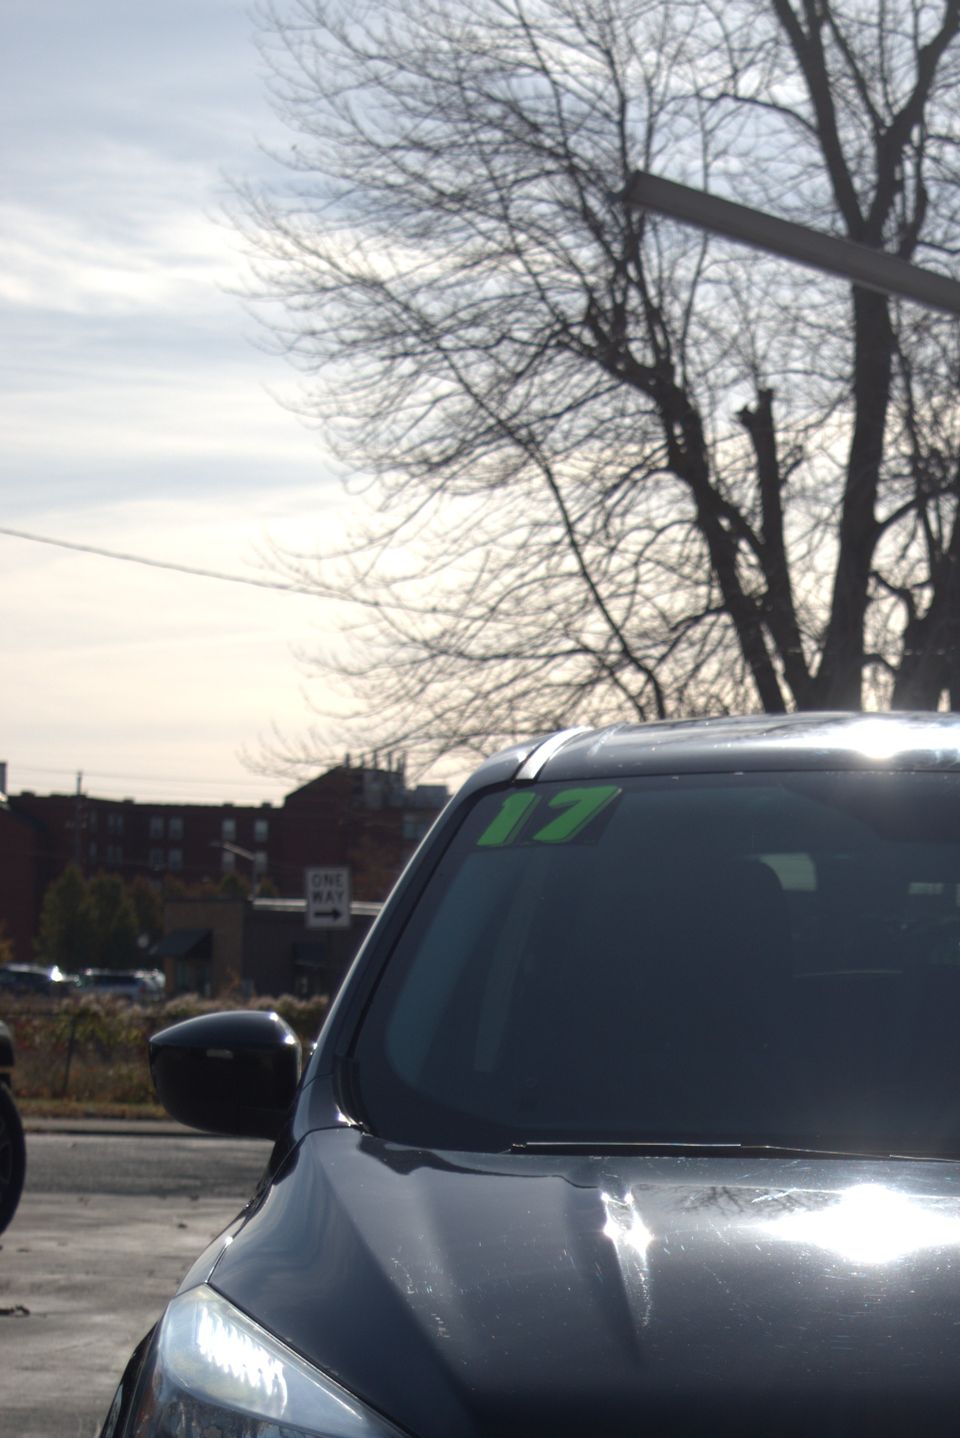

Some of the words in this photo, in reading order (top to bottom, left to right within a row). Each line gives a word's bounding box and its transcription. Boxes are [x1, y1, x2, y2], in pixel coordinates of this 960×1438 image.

[477, 785, 622, 846] 17
[312, 874, 343, 888] ONE
[313, 890, 344, 904] WAY
